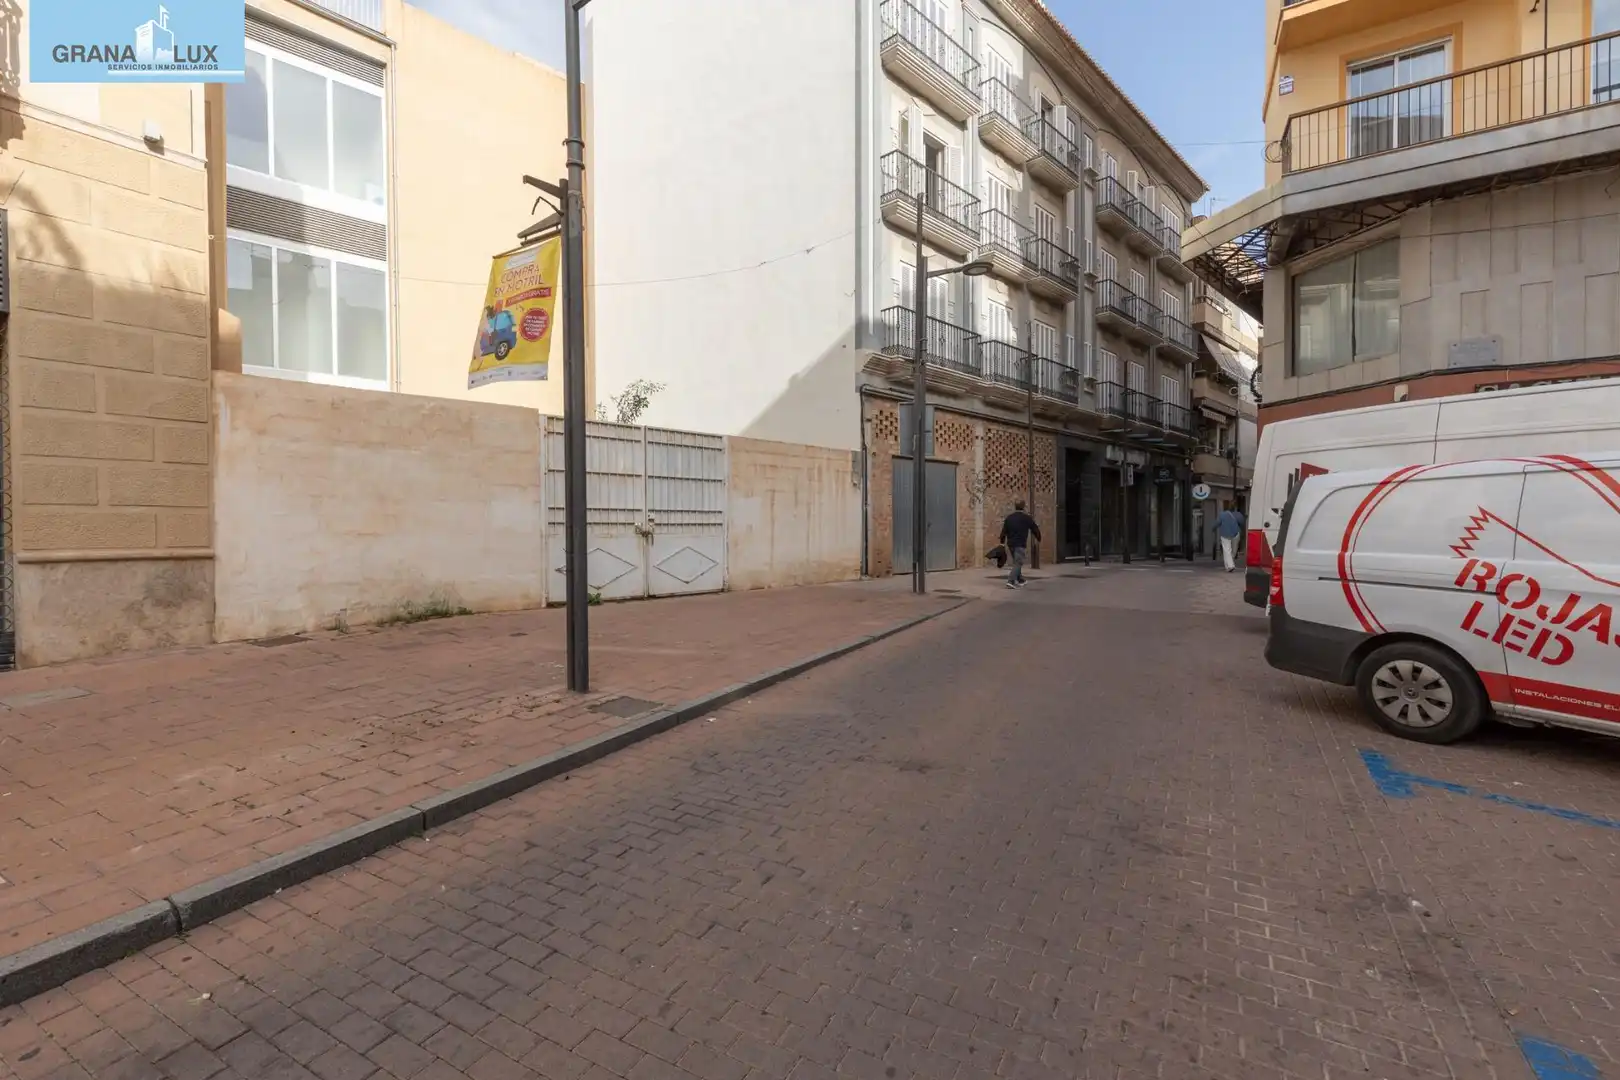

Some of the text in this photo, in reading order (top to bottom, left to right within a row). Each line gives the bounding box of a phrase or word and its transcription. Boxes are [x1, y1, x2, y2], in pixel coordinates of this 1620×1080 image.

[501, 264, 539, 284] COMPRA
[506, 273, 545, 293] MOTRIL
[1454, 558, 1620, 648] ROJA
[1460, 600, 1574, 666] LED
[1514, 688, 1602, 708] INSTALACIONES
